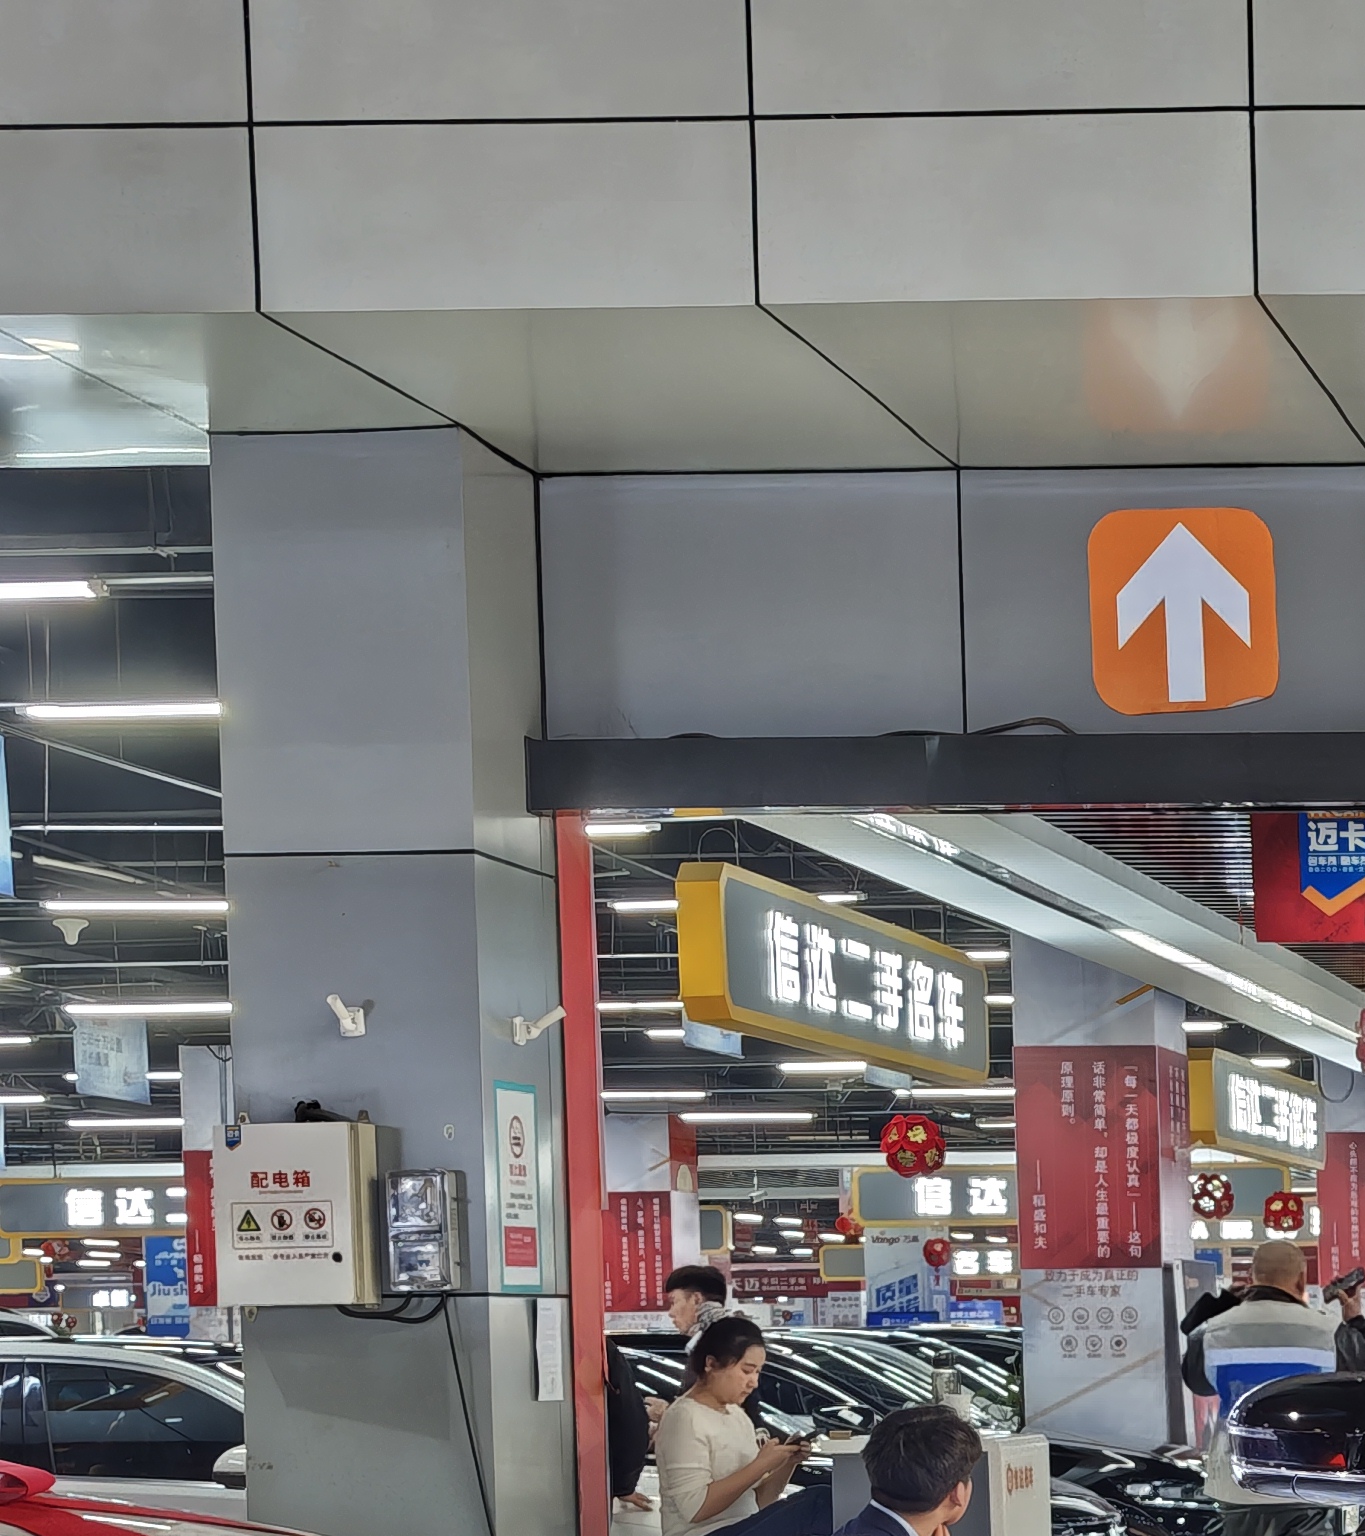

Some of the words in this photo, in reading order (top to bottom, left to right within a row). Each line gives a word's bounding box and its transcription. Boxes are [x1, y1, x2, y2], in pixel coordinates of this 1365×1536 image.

[765, 908, 966, 1051] 信达二手名车
[250, 1170, 311, 1189] 配电箱
[912, 1176, 1009, 1216] 信达
[1044, 1269, 1139, 1282] 致力于成为真正的
[1062, 1284, 1122, 1298] 二手车专家
